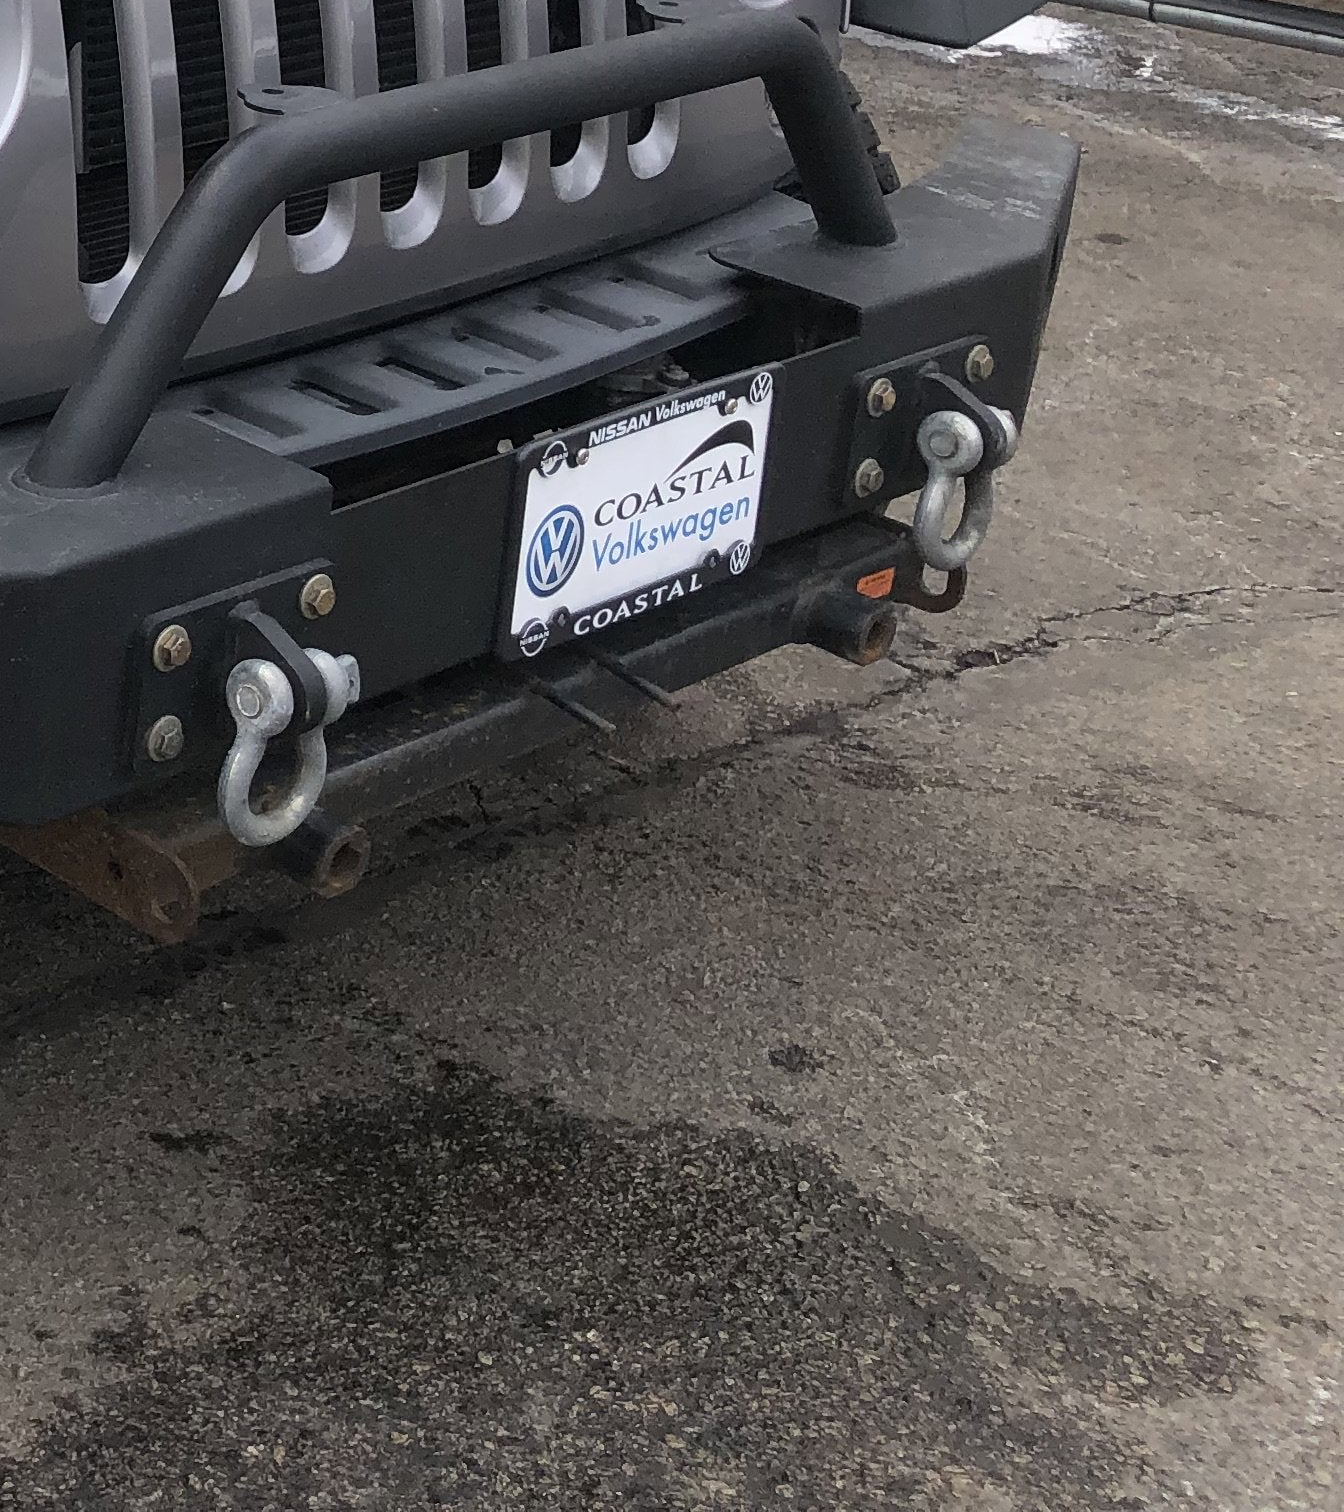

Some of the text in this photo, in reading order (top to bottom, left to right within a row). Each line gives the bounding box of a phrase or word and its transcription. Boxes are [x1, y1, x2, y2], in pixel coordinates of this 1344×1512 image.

[588, 390, 726, 447] NISSAN Volkswagen
[594, 455, 756, 527] COASTAL
[591, 496, 750, 572] Volkswagen
[573, 573, 703, 636] COASTAL
